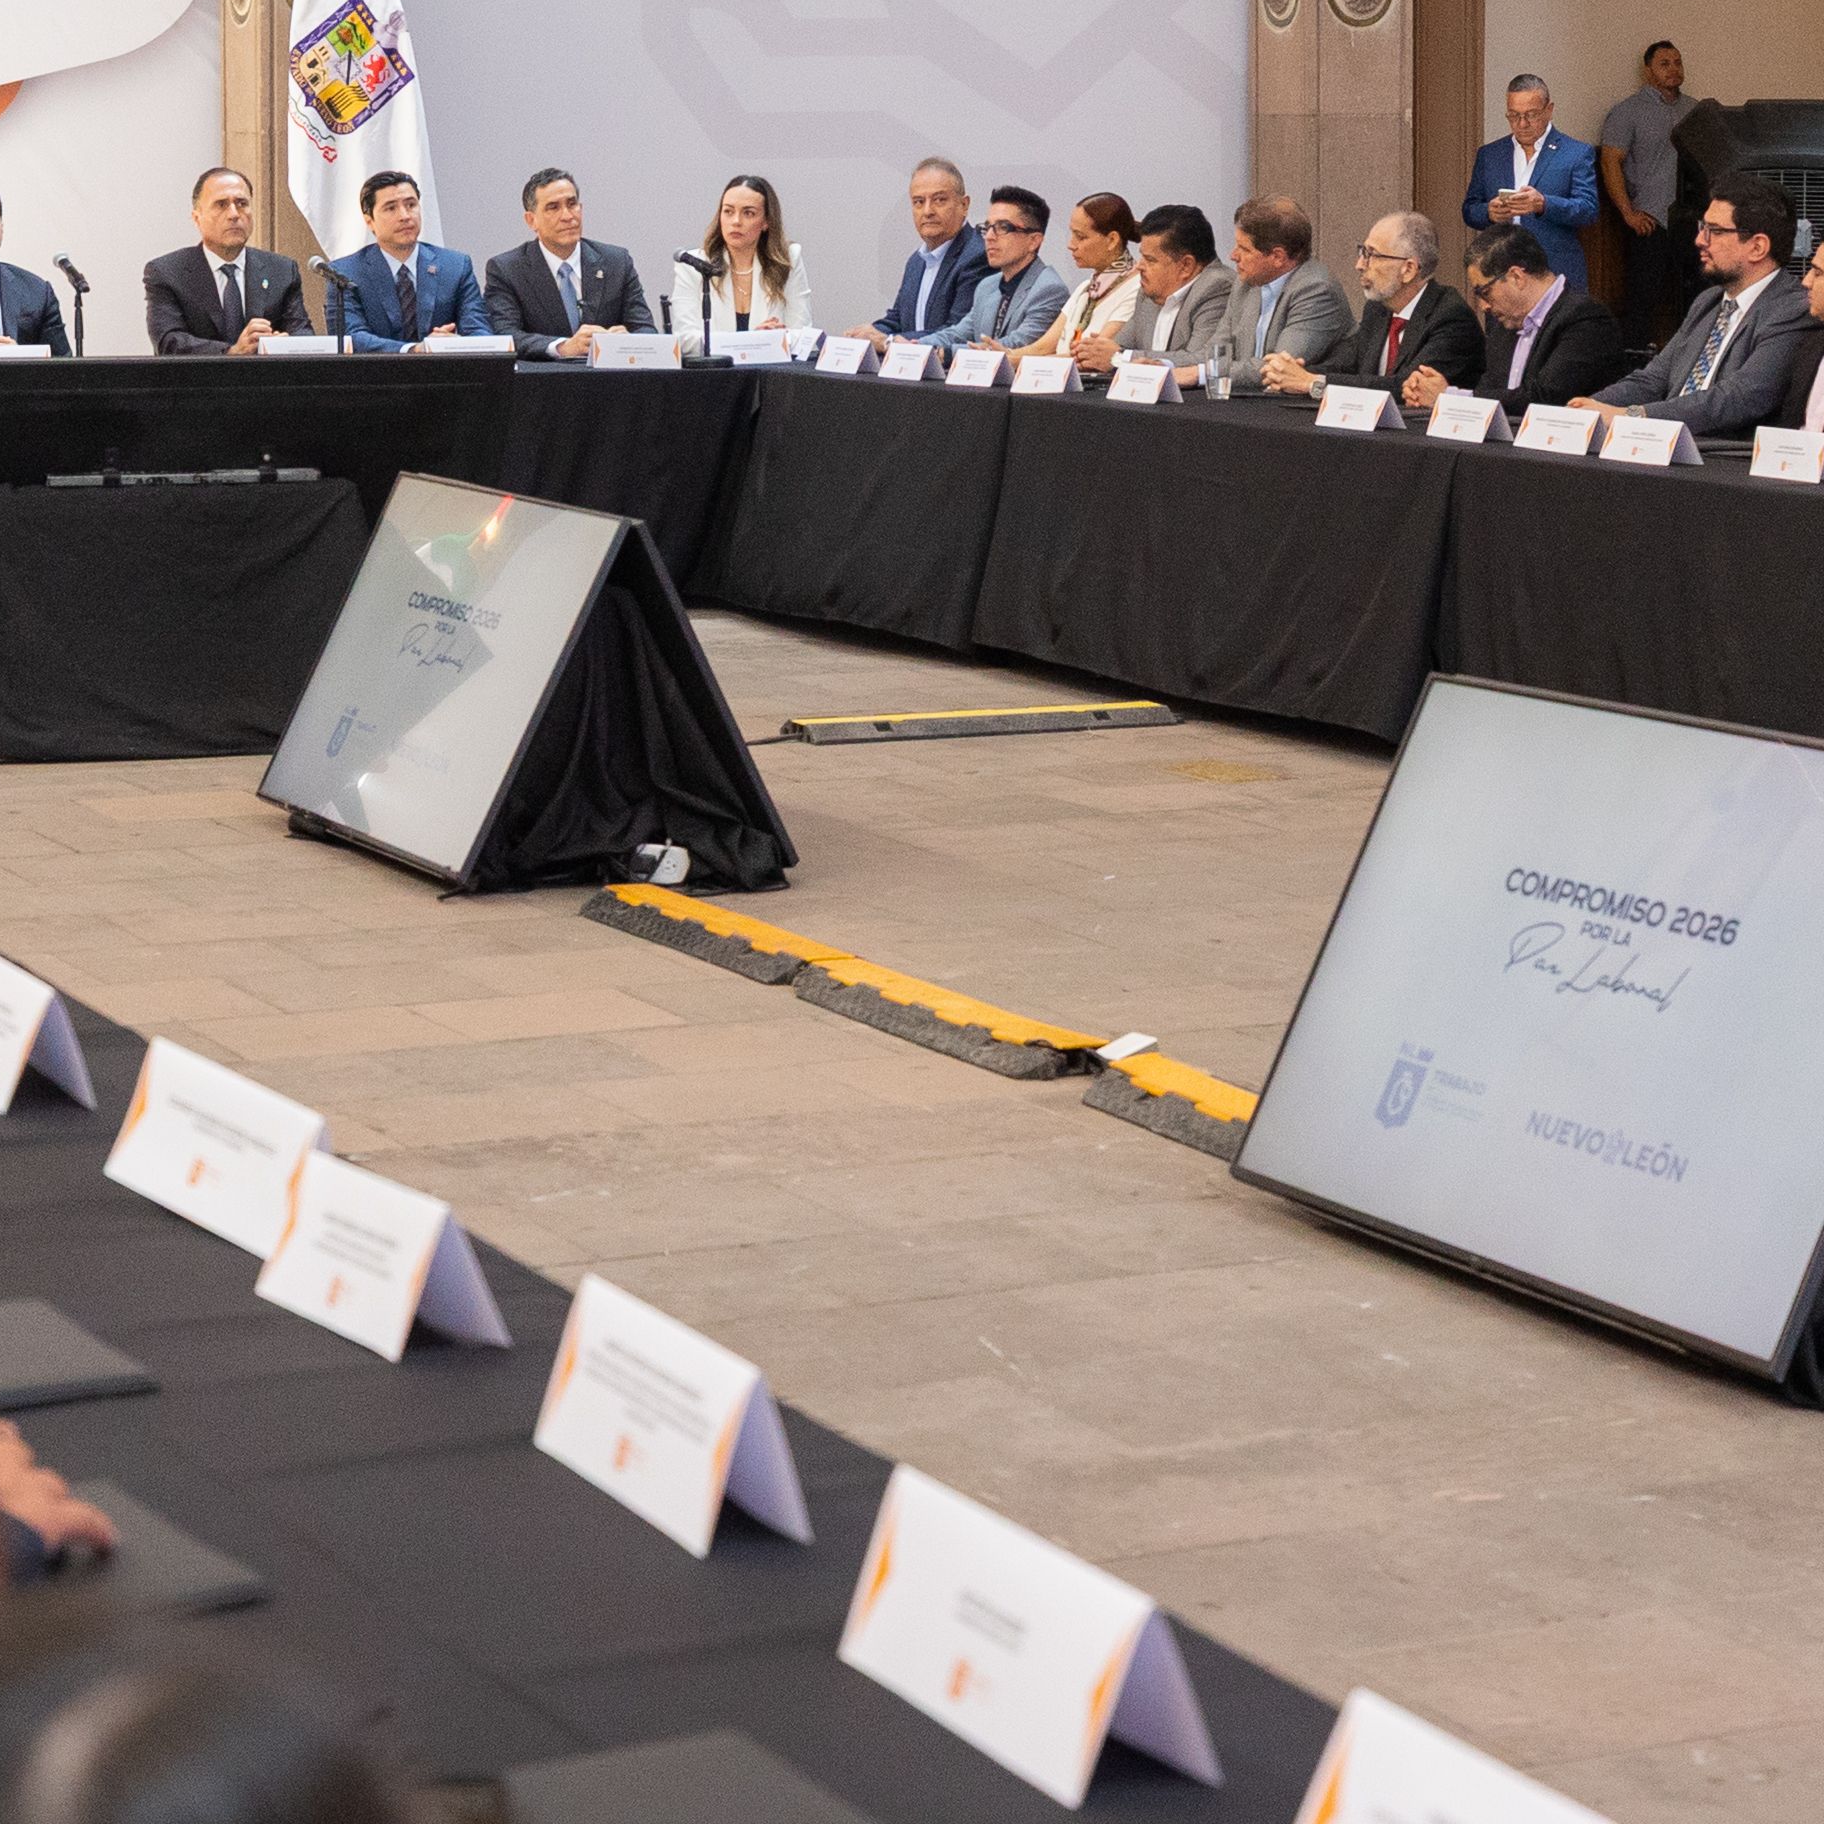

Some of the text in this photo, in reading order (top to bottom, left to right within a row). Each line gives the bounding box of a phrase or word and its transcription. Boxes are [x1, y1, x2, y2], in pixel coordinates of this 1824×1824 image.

[408, 590, 474, 623] COMPROMISO
[1504, 867, 1741, 946] COMPROMISO 2026
[1580, 920, 1633, 947] POR LA
[1555, 943, 1692, 1013] Laboral
[1525, 1109, 1605, 1157] NUEVO
